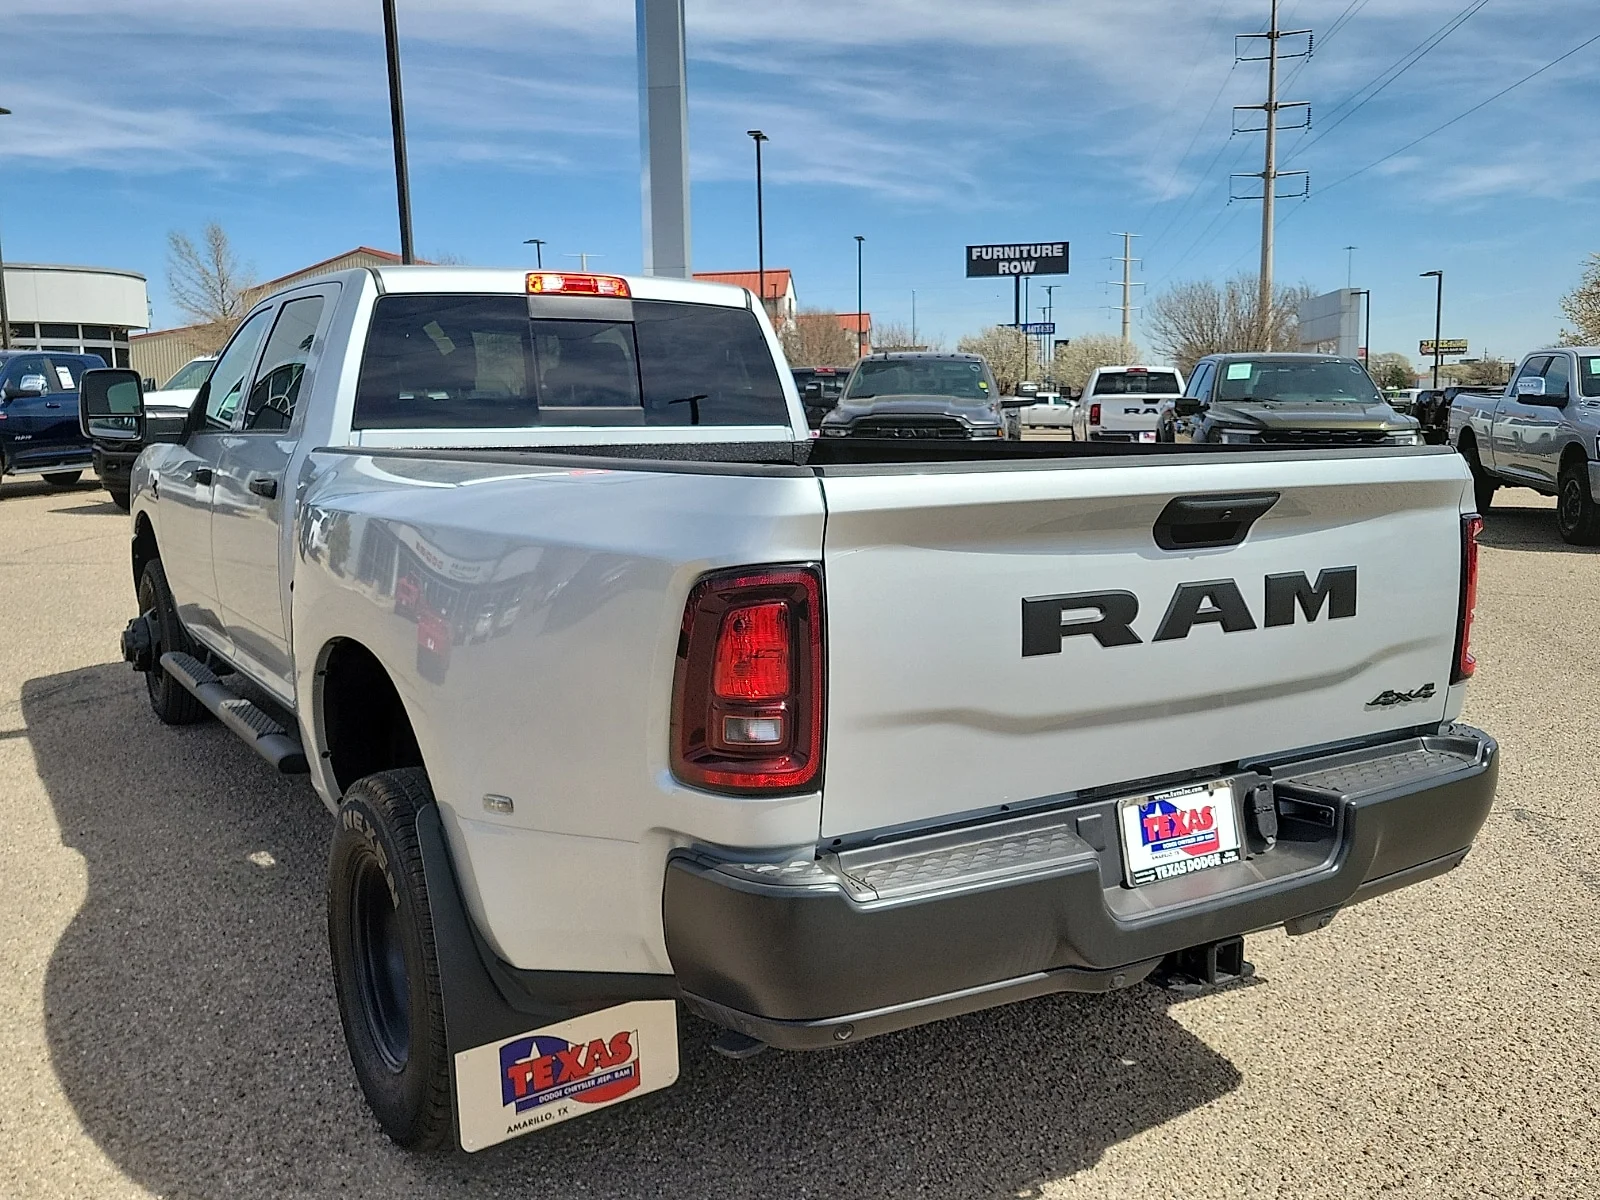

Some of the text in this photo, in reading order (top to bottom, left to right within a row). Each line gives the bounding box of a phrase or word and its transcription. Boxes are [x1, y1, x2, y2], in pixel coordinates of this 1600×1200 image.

[971, 244, 1064, 260] FURNITURE
[998, 260, 1036, 274] ROW
[1021, 565, 1358, 657] RAM
[1143, 806, 1214, 841] TEXAS
[1155, 861, 1187, 879] TEXAS
[1187, 854, 1221, 872] DODGE
[508, 1031, 632, 1097] TEXAS
[539, 1091, 563, 1103] DODGE
[564, 1079, 596, 1095] CHRYSLER
[614, 1068, 630, 1079] RAM
[506, 1106, 569, 1134] AMARILLO, TX
